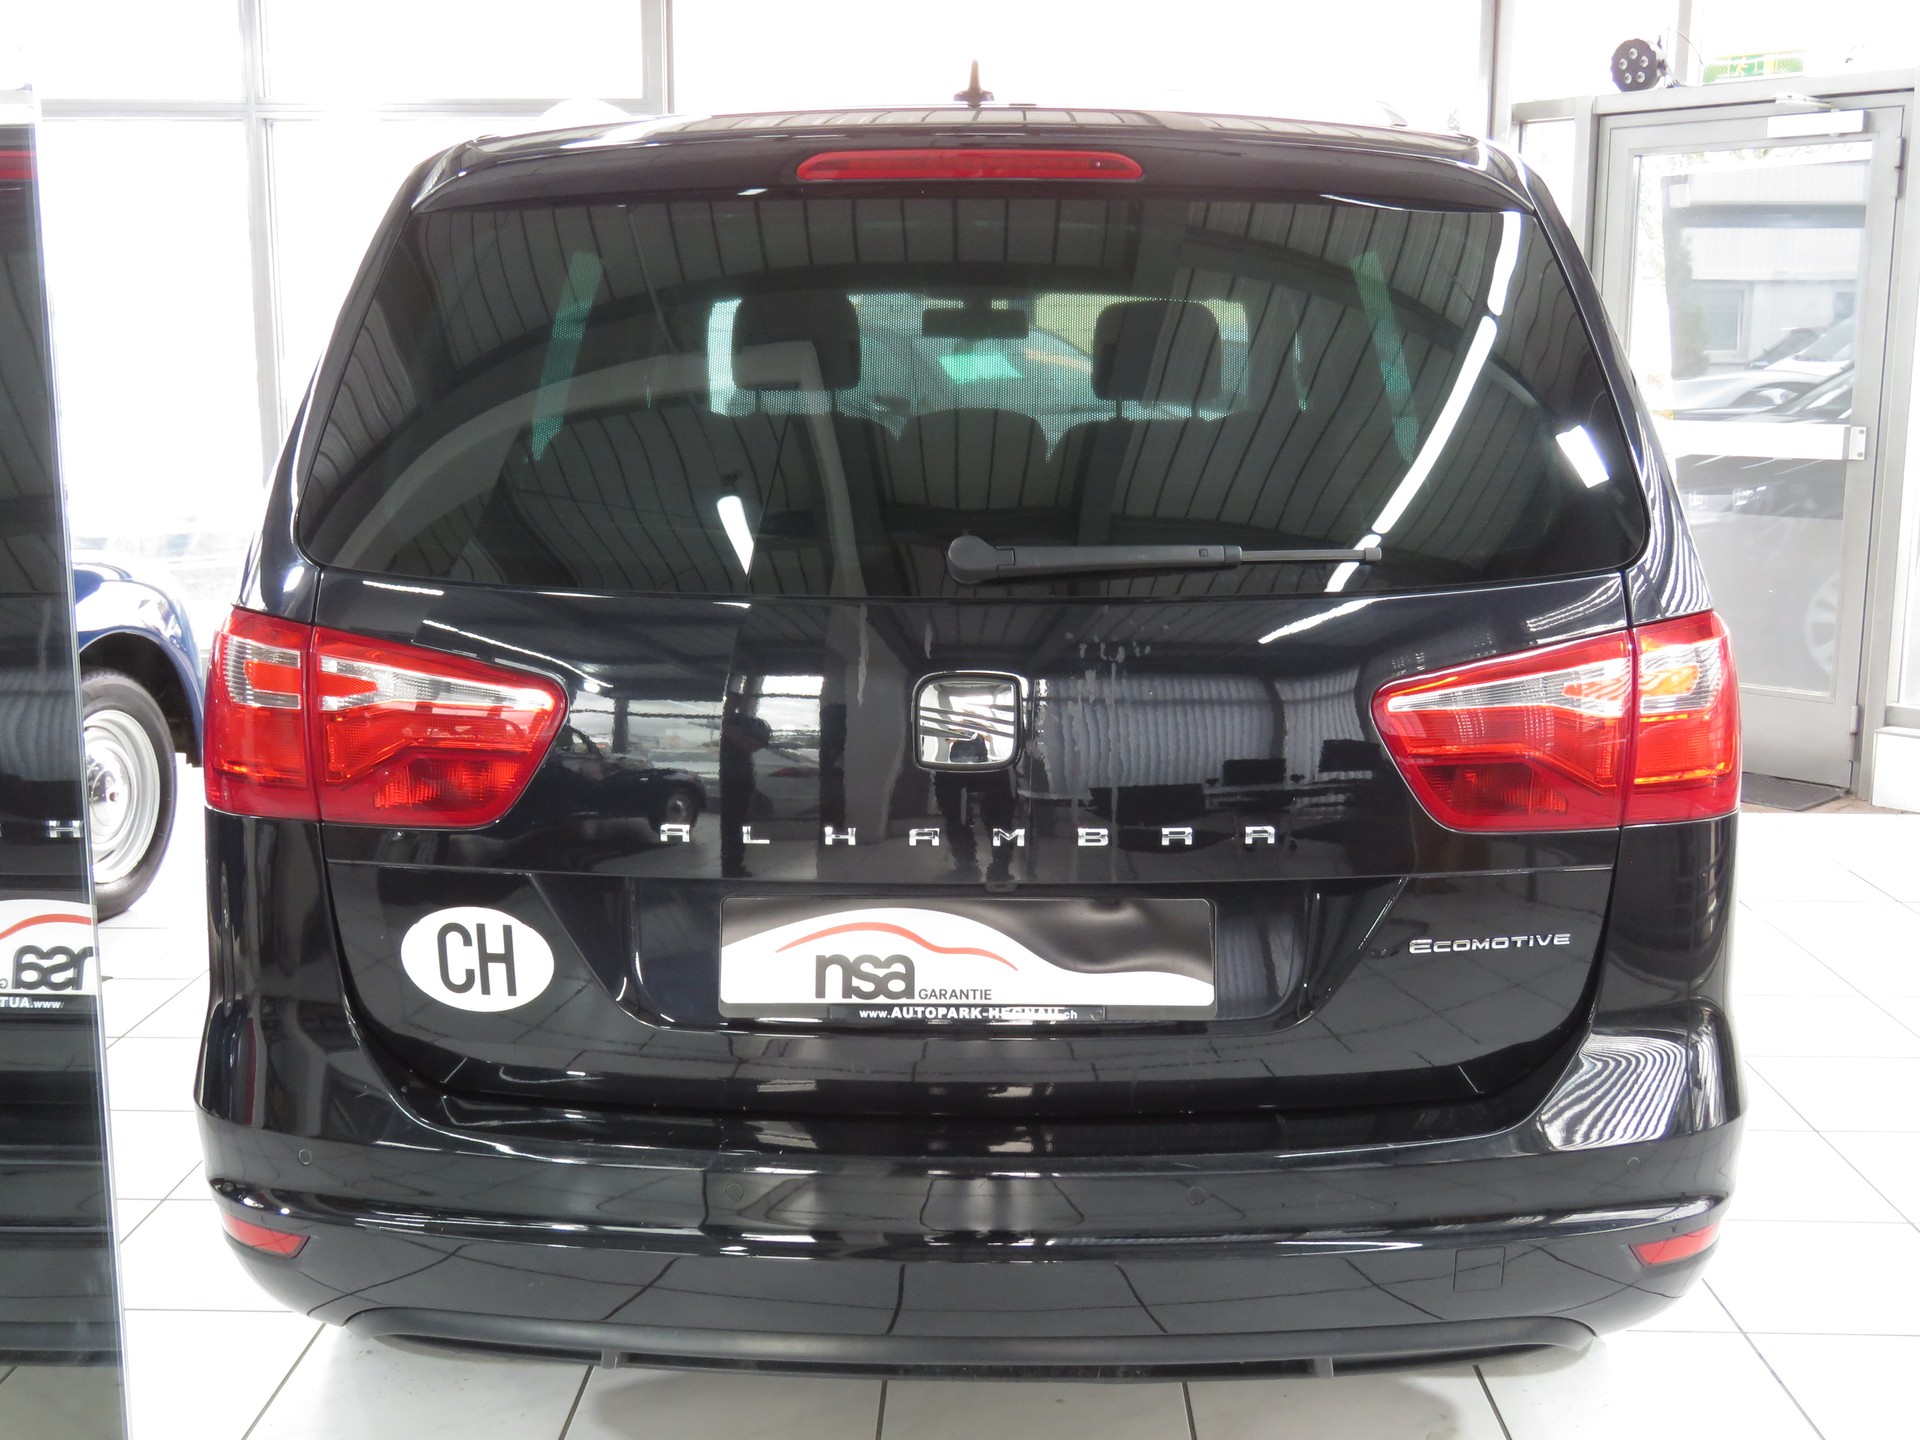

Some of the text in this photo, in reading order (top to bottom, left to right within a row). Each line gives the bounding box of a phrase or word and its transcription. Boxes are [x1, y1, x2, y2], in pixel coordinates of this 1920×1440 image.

[660, 823, 1276, 847] ALHAMBRA
[437, 922, 517, 996] CH
[815, 954, 992, 1000] nsa GARANTIE
[859, 1006, 1078, 1020] www.AUTOPARK-HEGNAUch
